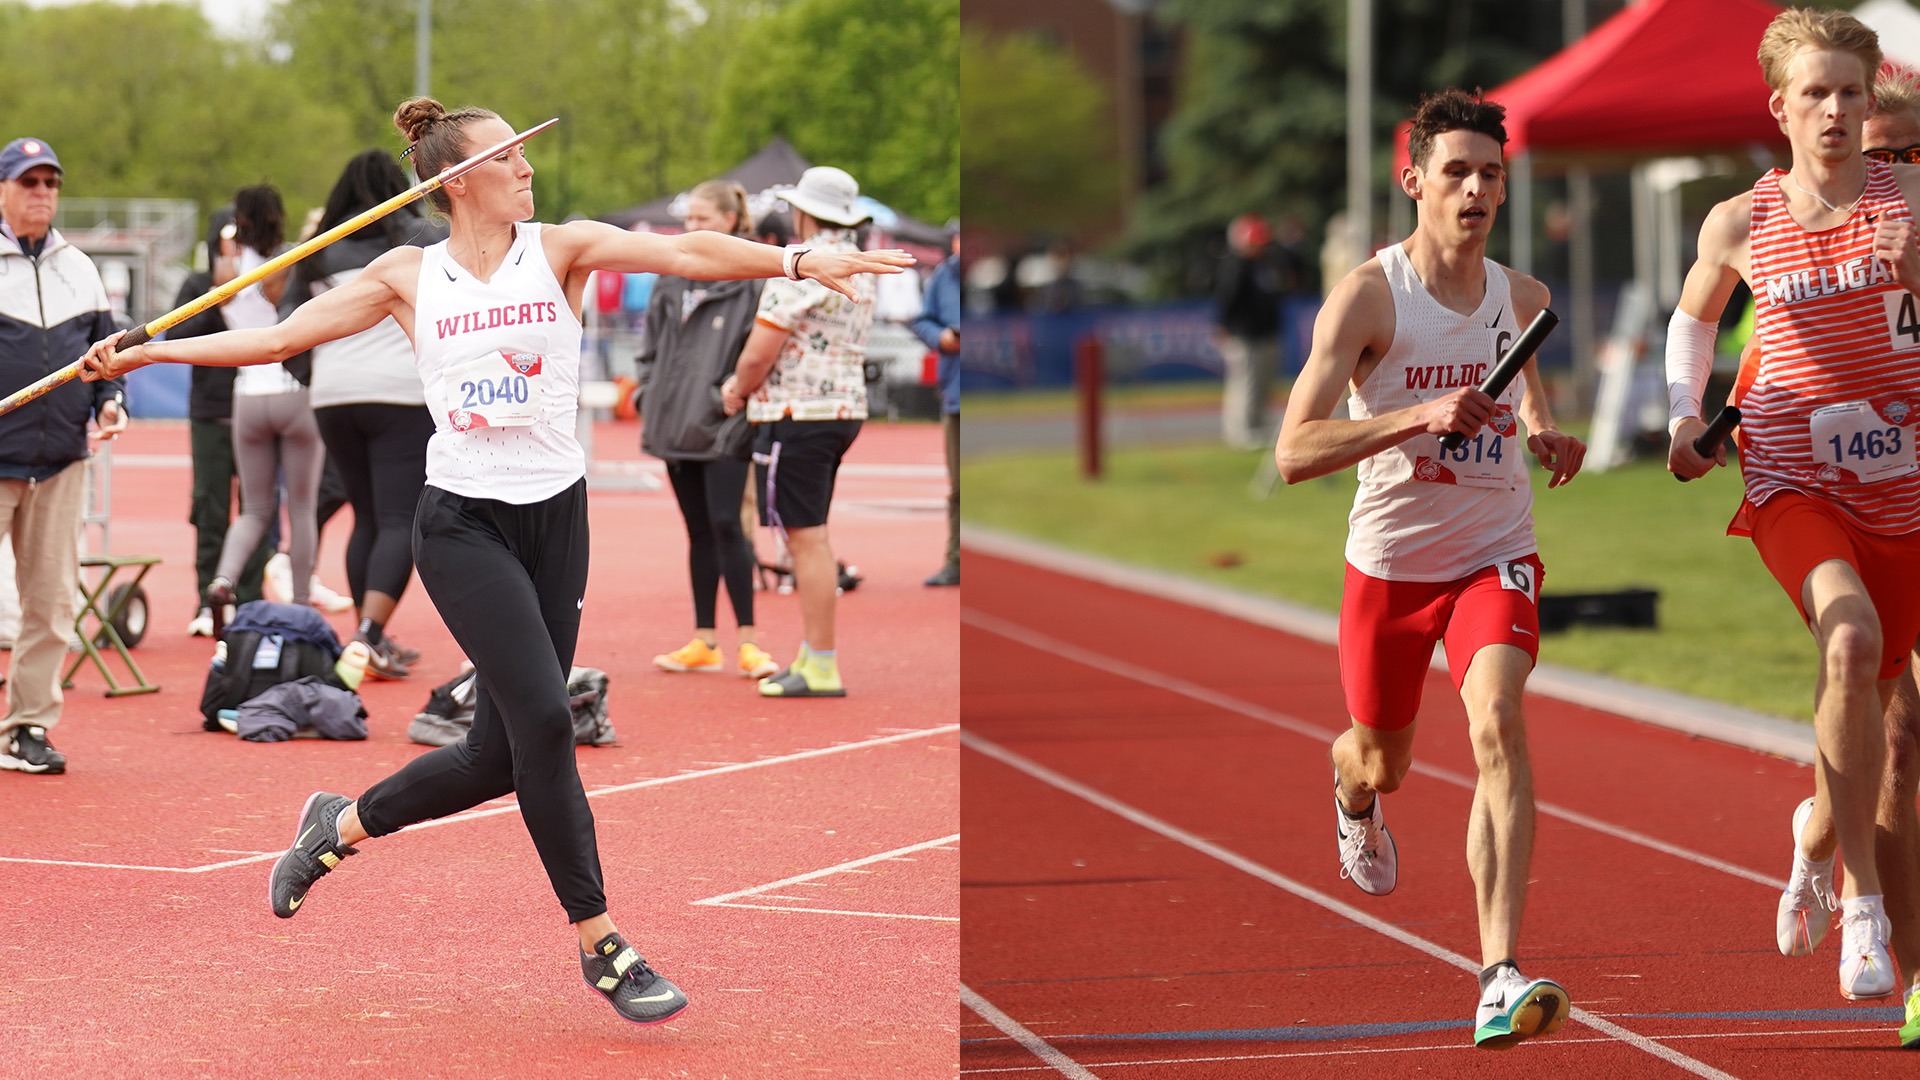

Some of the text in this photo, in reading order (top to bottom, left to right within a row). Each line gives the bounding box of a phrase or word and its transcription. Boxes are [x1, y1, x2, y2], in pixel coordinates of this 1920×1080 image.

[1764, 255, 1898, 307] MILLIGA
[436, 301, 557, 340] WILDCATS
[1897, 292, 1920, 344] 4
[460, 375, 529, 409] 2040
[1405, 363, 1488, 389] WILDC
[1828, 426, 1902, 463] 1463
[1507, 562, 1530, 593] 6
